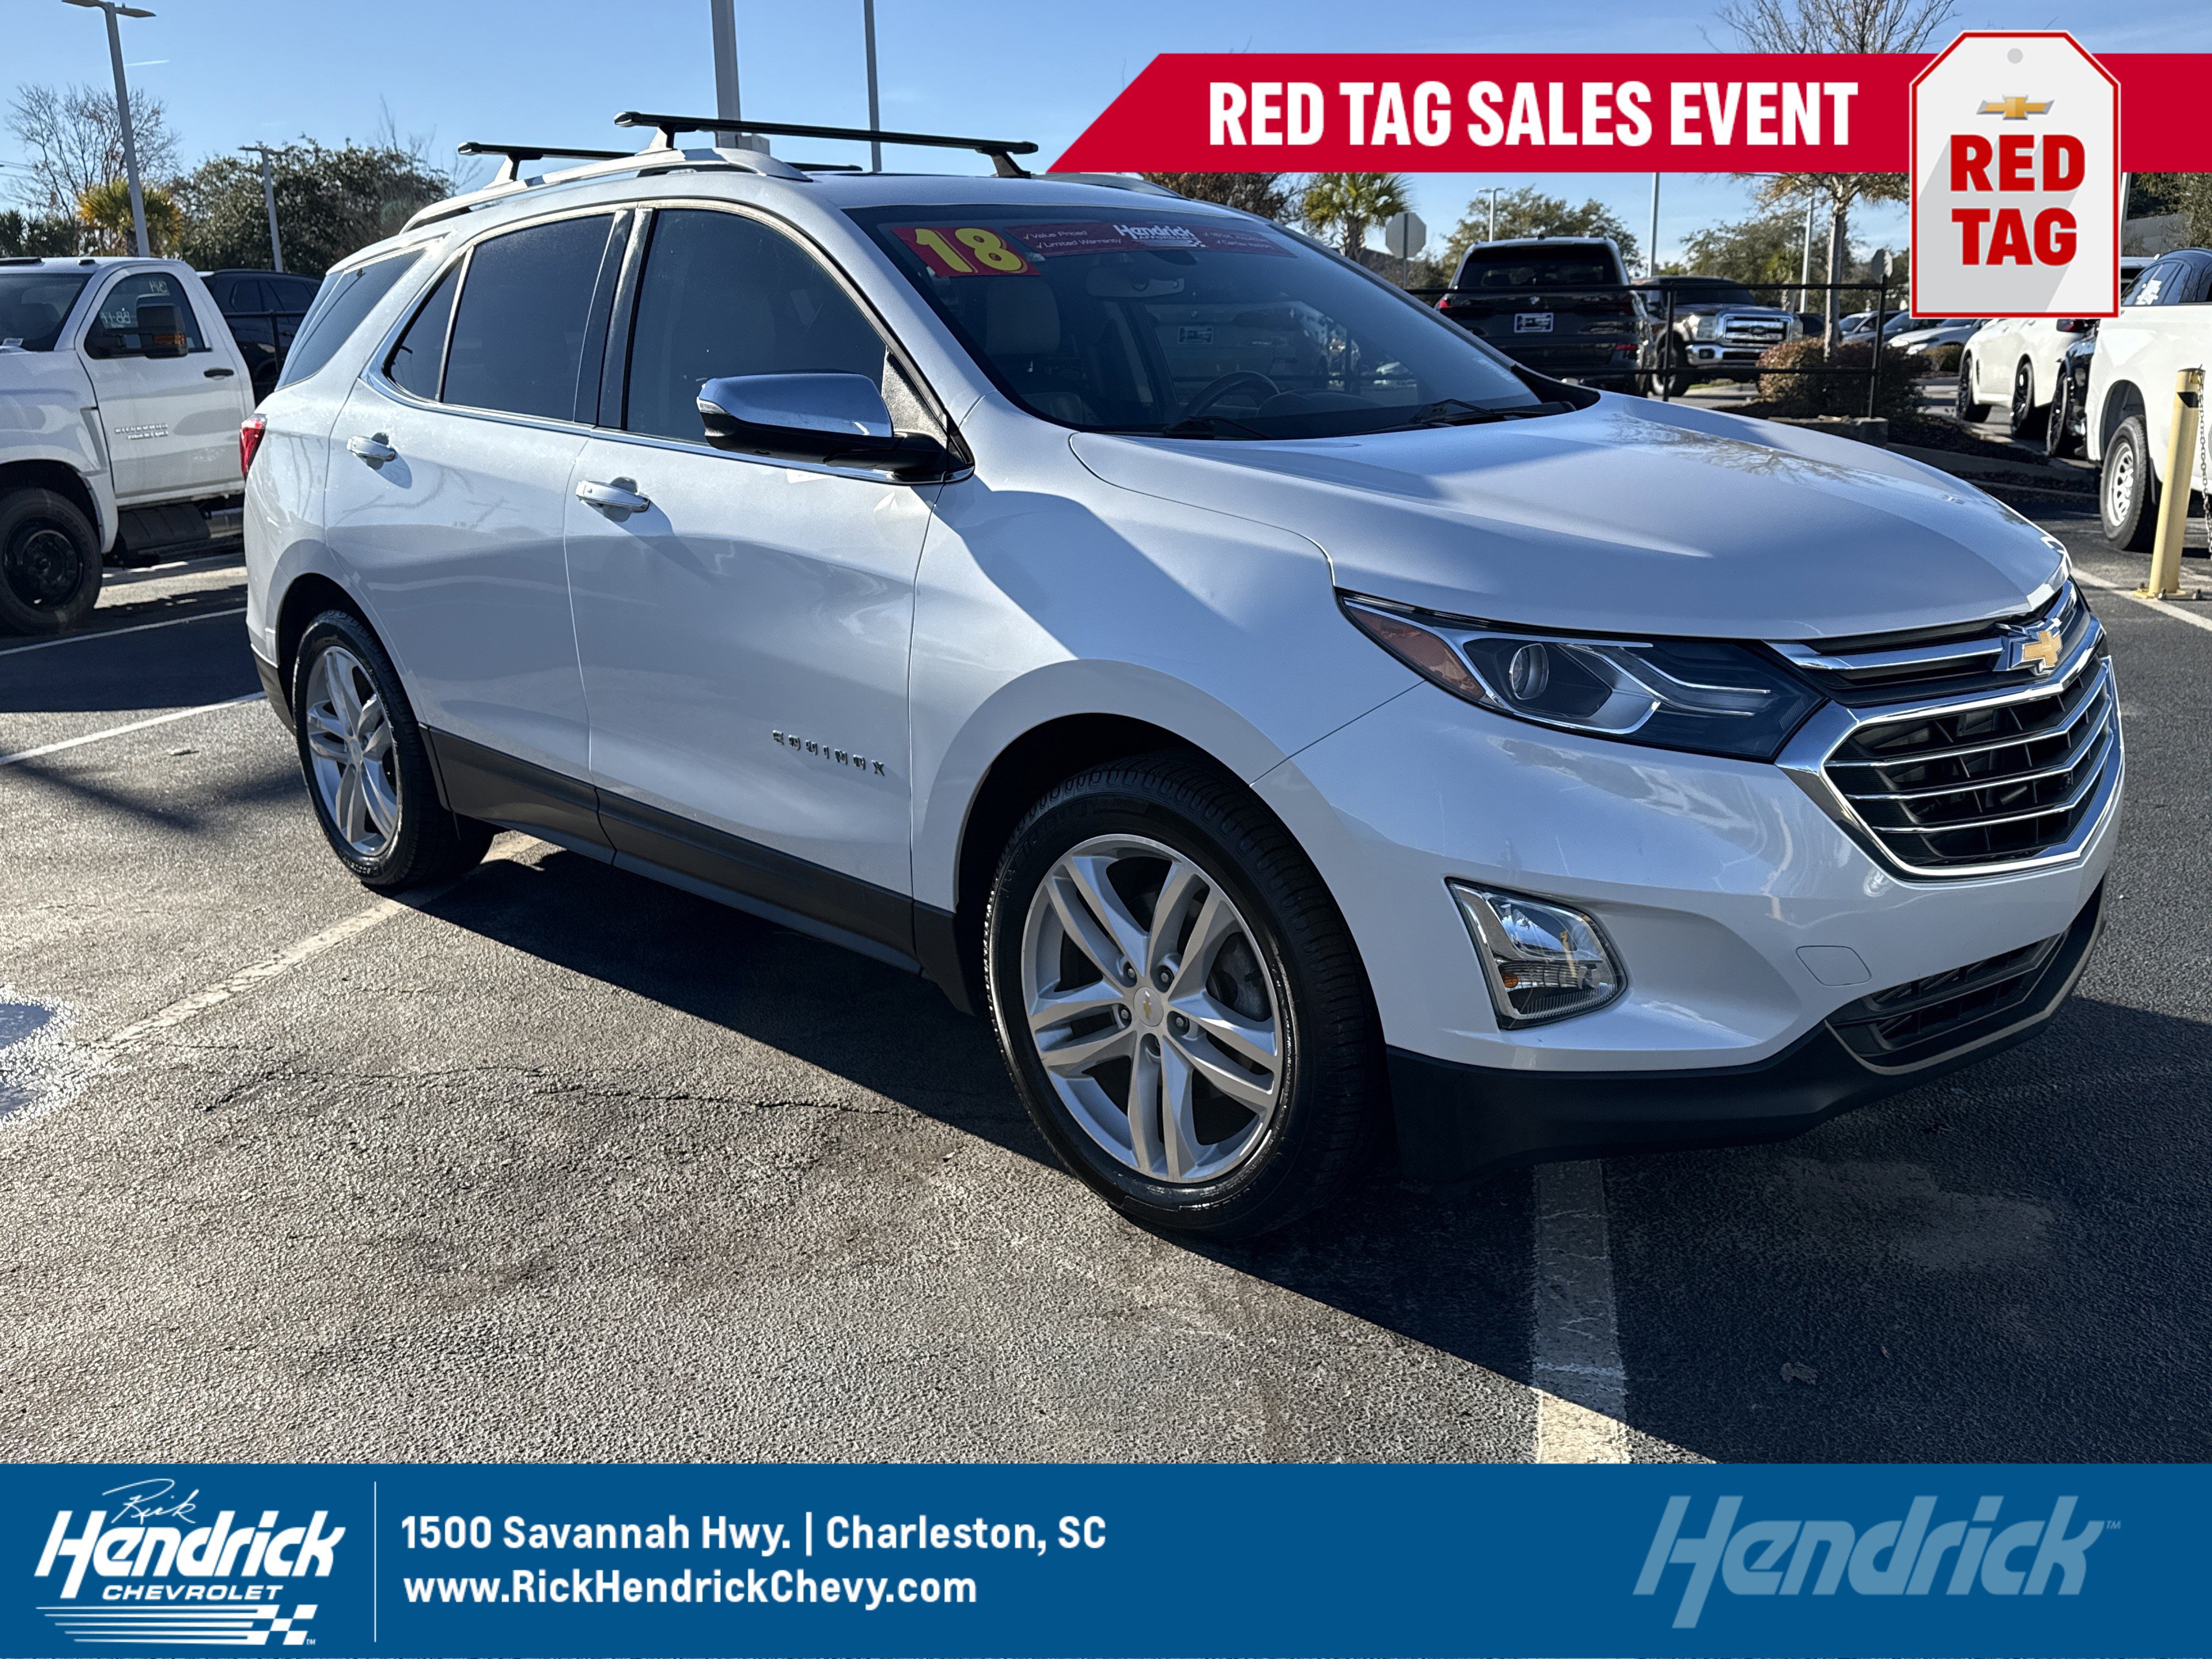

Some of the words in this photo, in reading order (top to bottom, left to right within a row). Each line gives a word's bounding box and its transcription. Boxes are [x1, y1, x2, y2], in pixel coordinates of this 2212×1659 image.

[1045, 239, 1078, 247] Limited
[1113, 224, 1197, 240] Hendrick
[915, 228, 1028, 273] 18
[772, 730, 885, 776] EQUINOX
